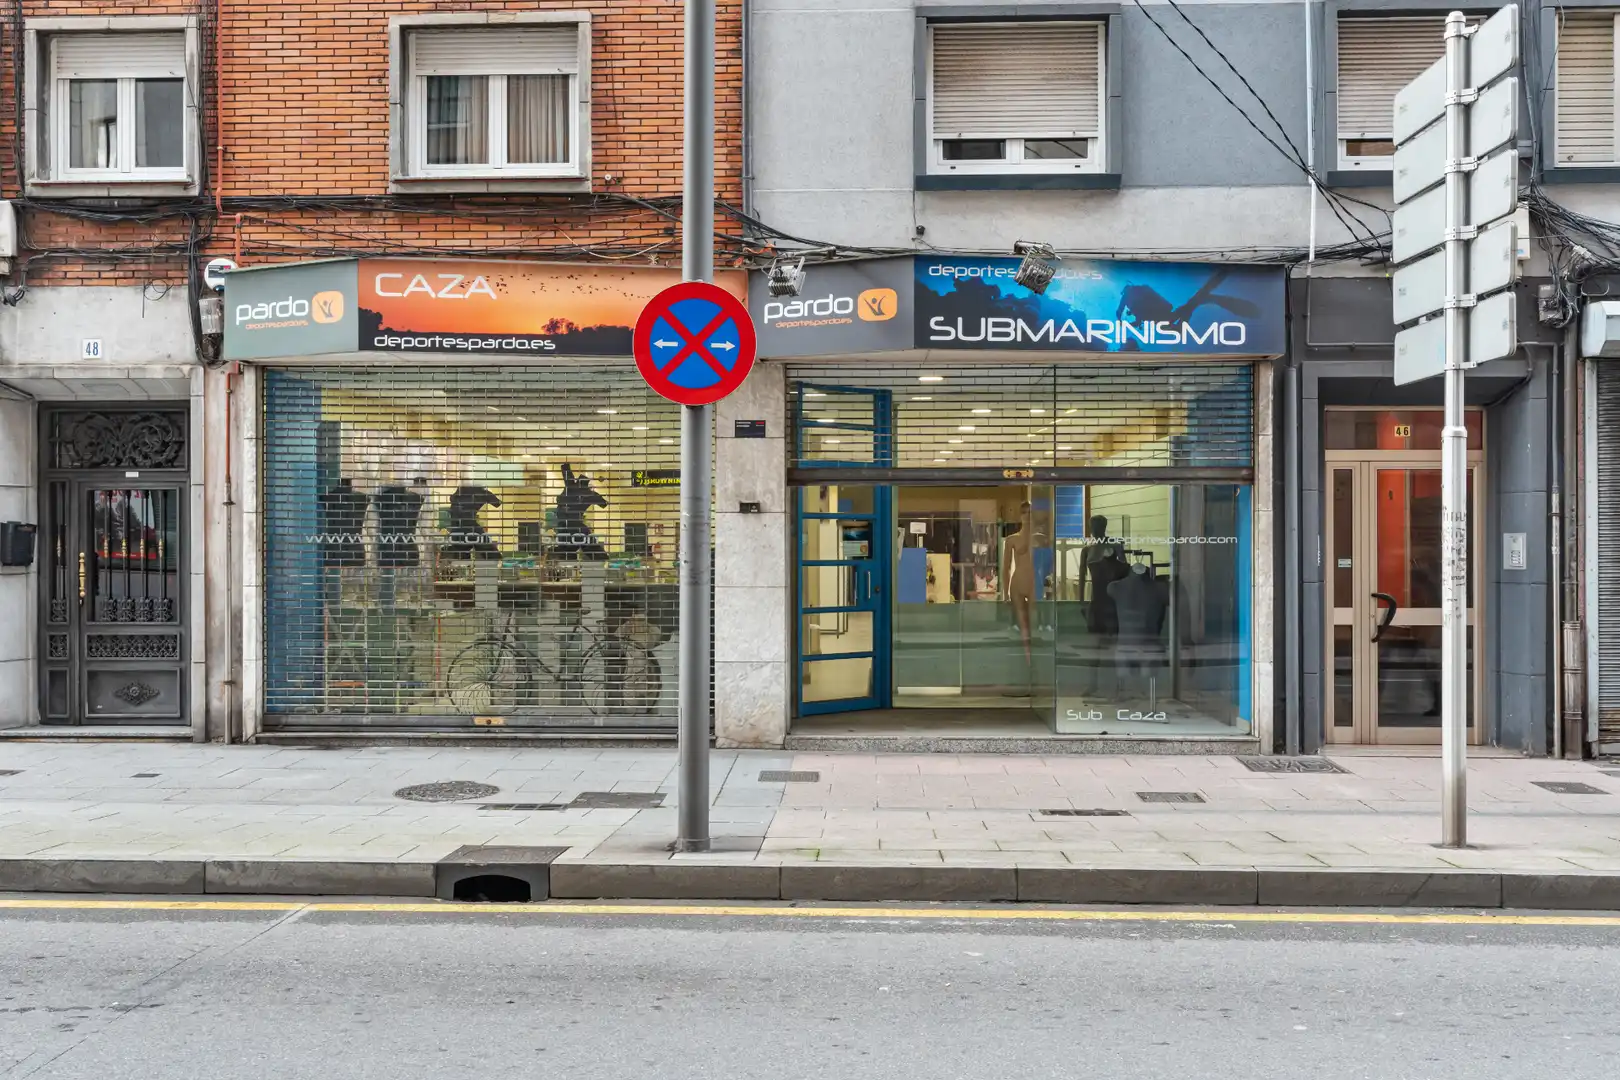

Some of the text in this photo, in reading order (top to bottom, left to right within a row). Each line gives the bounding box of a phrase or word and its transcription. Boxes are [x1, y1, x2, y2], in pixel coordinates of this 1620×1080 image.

[375, 273, 497, 300] CAZA
[235, 296, 309, 326] pardo
[764, 294, 853, 324] pardo
[929, 316, 1246, 346] SUBMARINISMO
[85, 341, 99, 356] 48
[374, 335, 556, 351] deportespardo.es
[1396, 426, 1409, 436] 46
[1066, 709, 1166, 721] Sub Caza
